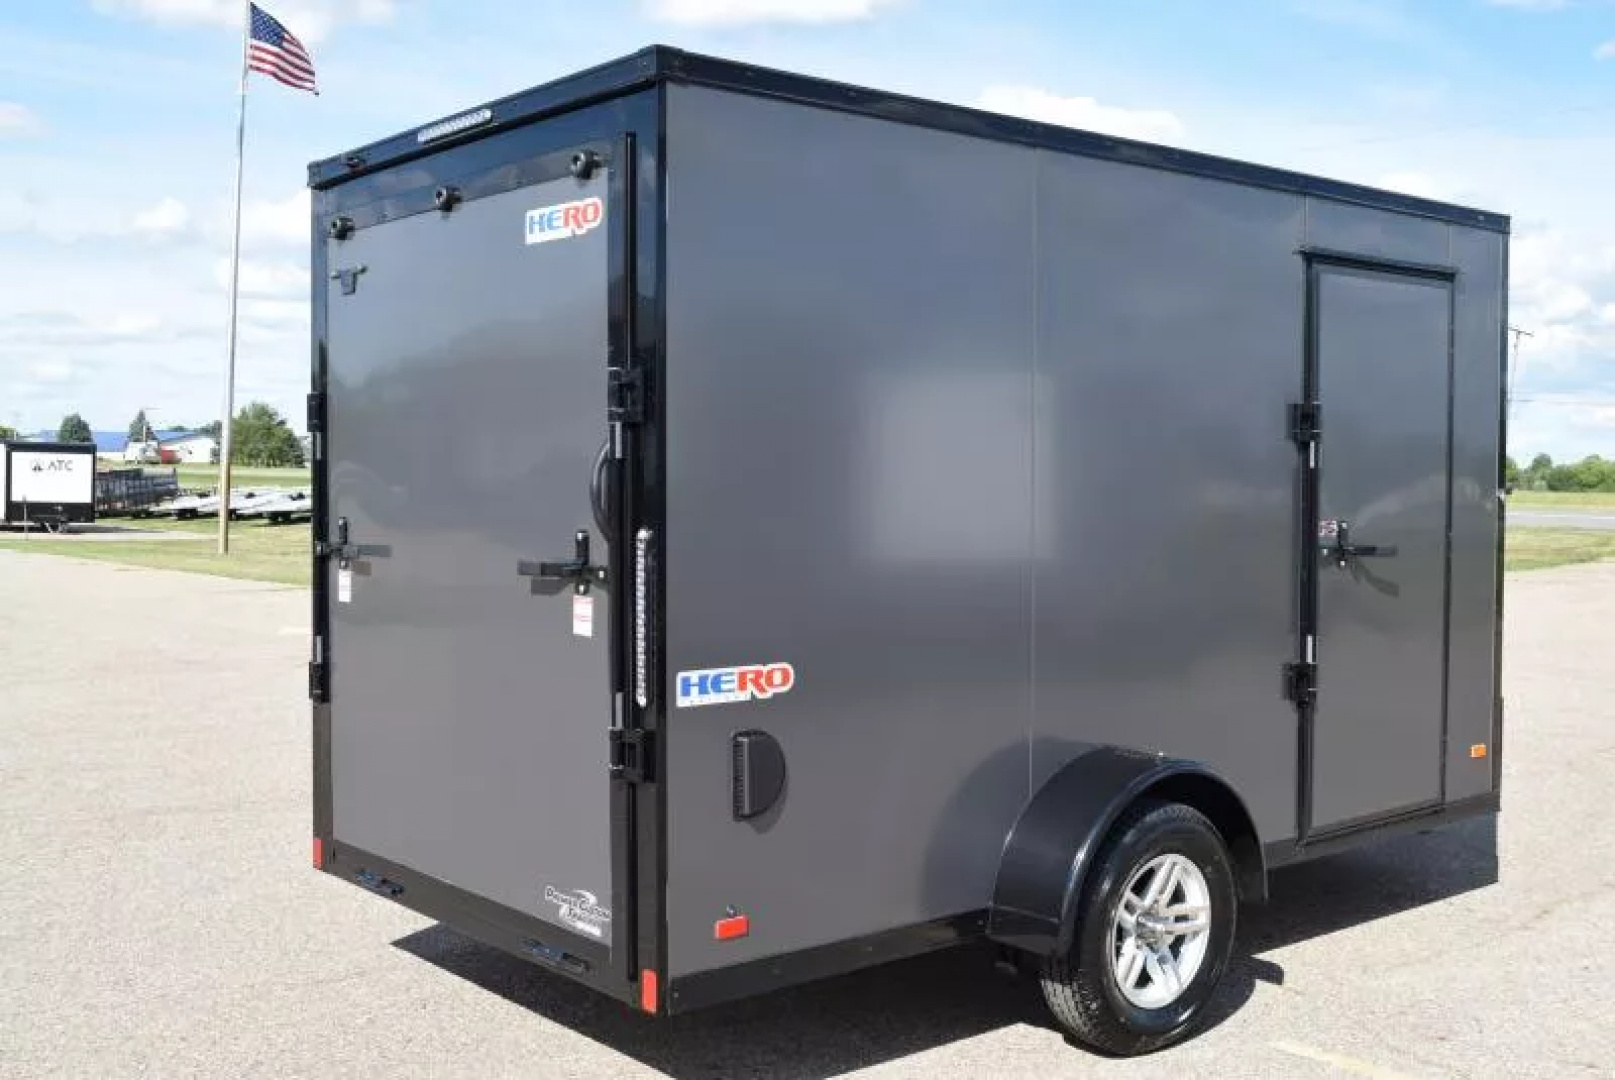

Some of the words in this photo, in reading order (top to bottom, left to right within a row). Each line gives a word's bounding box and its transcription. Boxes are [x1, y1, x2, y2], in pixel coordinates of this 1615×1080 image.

[528, 202, 600, 234] HERO
[47, 459, 73, 471] ATC
[681, 667, 790, 697] HERO
